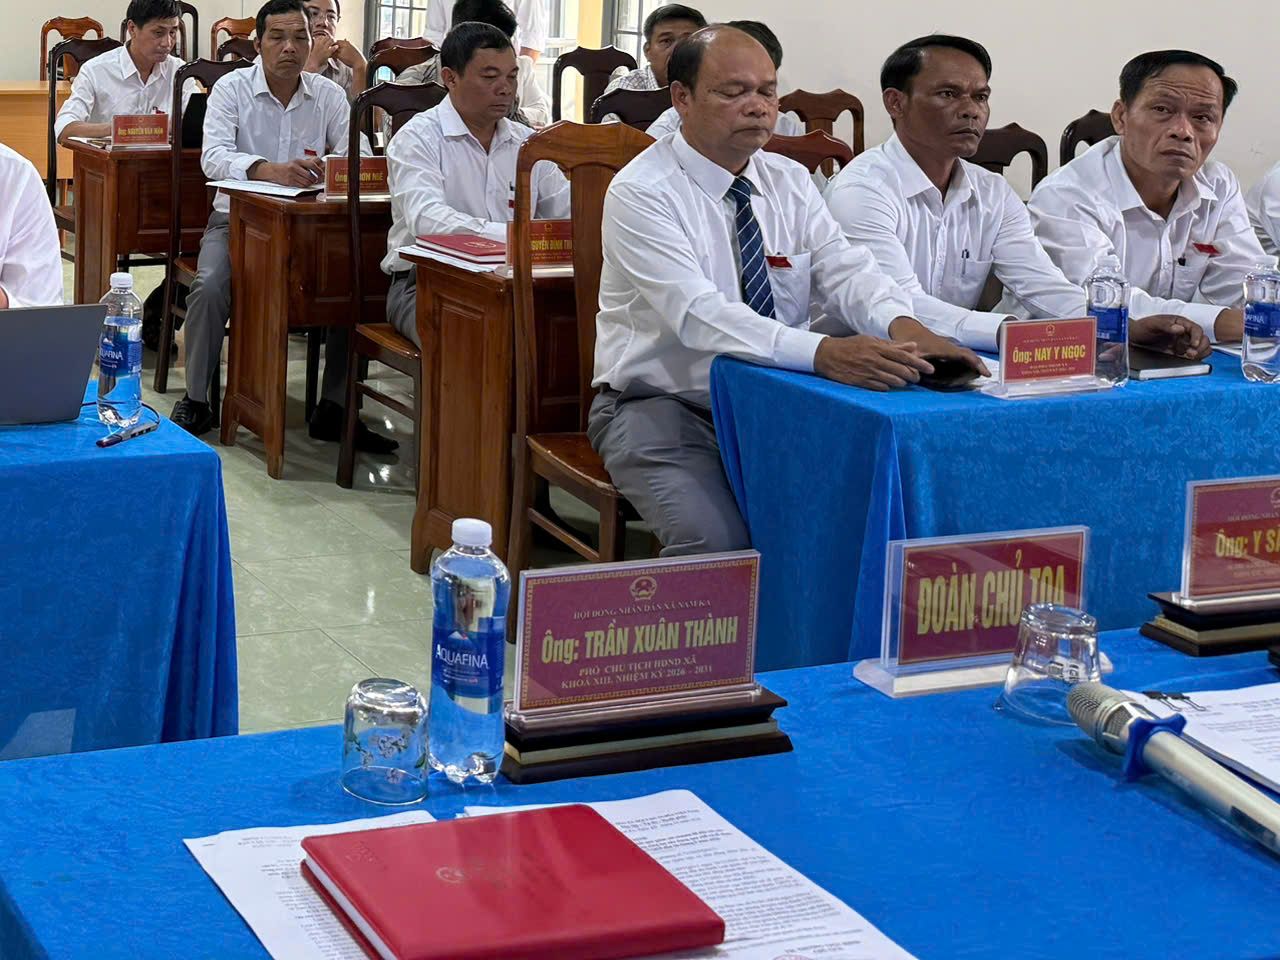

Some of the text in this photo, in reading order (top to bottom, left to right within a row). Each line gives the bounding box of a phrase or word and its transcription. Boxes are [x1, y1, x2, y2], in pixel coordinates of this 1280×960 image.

[1013, 345, 1086, 363] Ông: NAY Y NGỌC
[1216, 528, 1248, 558] Ông:
[1253, 530, 1262, 554] Y
[917, 562, 976, 635] ĐOÀN
[982, 549, 1024, 629] CHỦ
[541, 613, 739, 664] Ông: TRẦN XUÂN THÀNH
[435, 644, 489, 670] AQUAFINA
